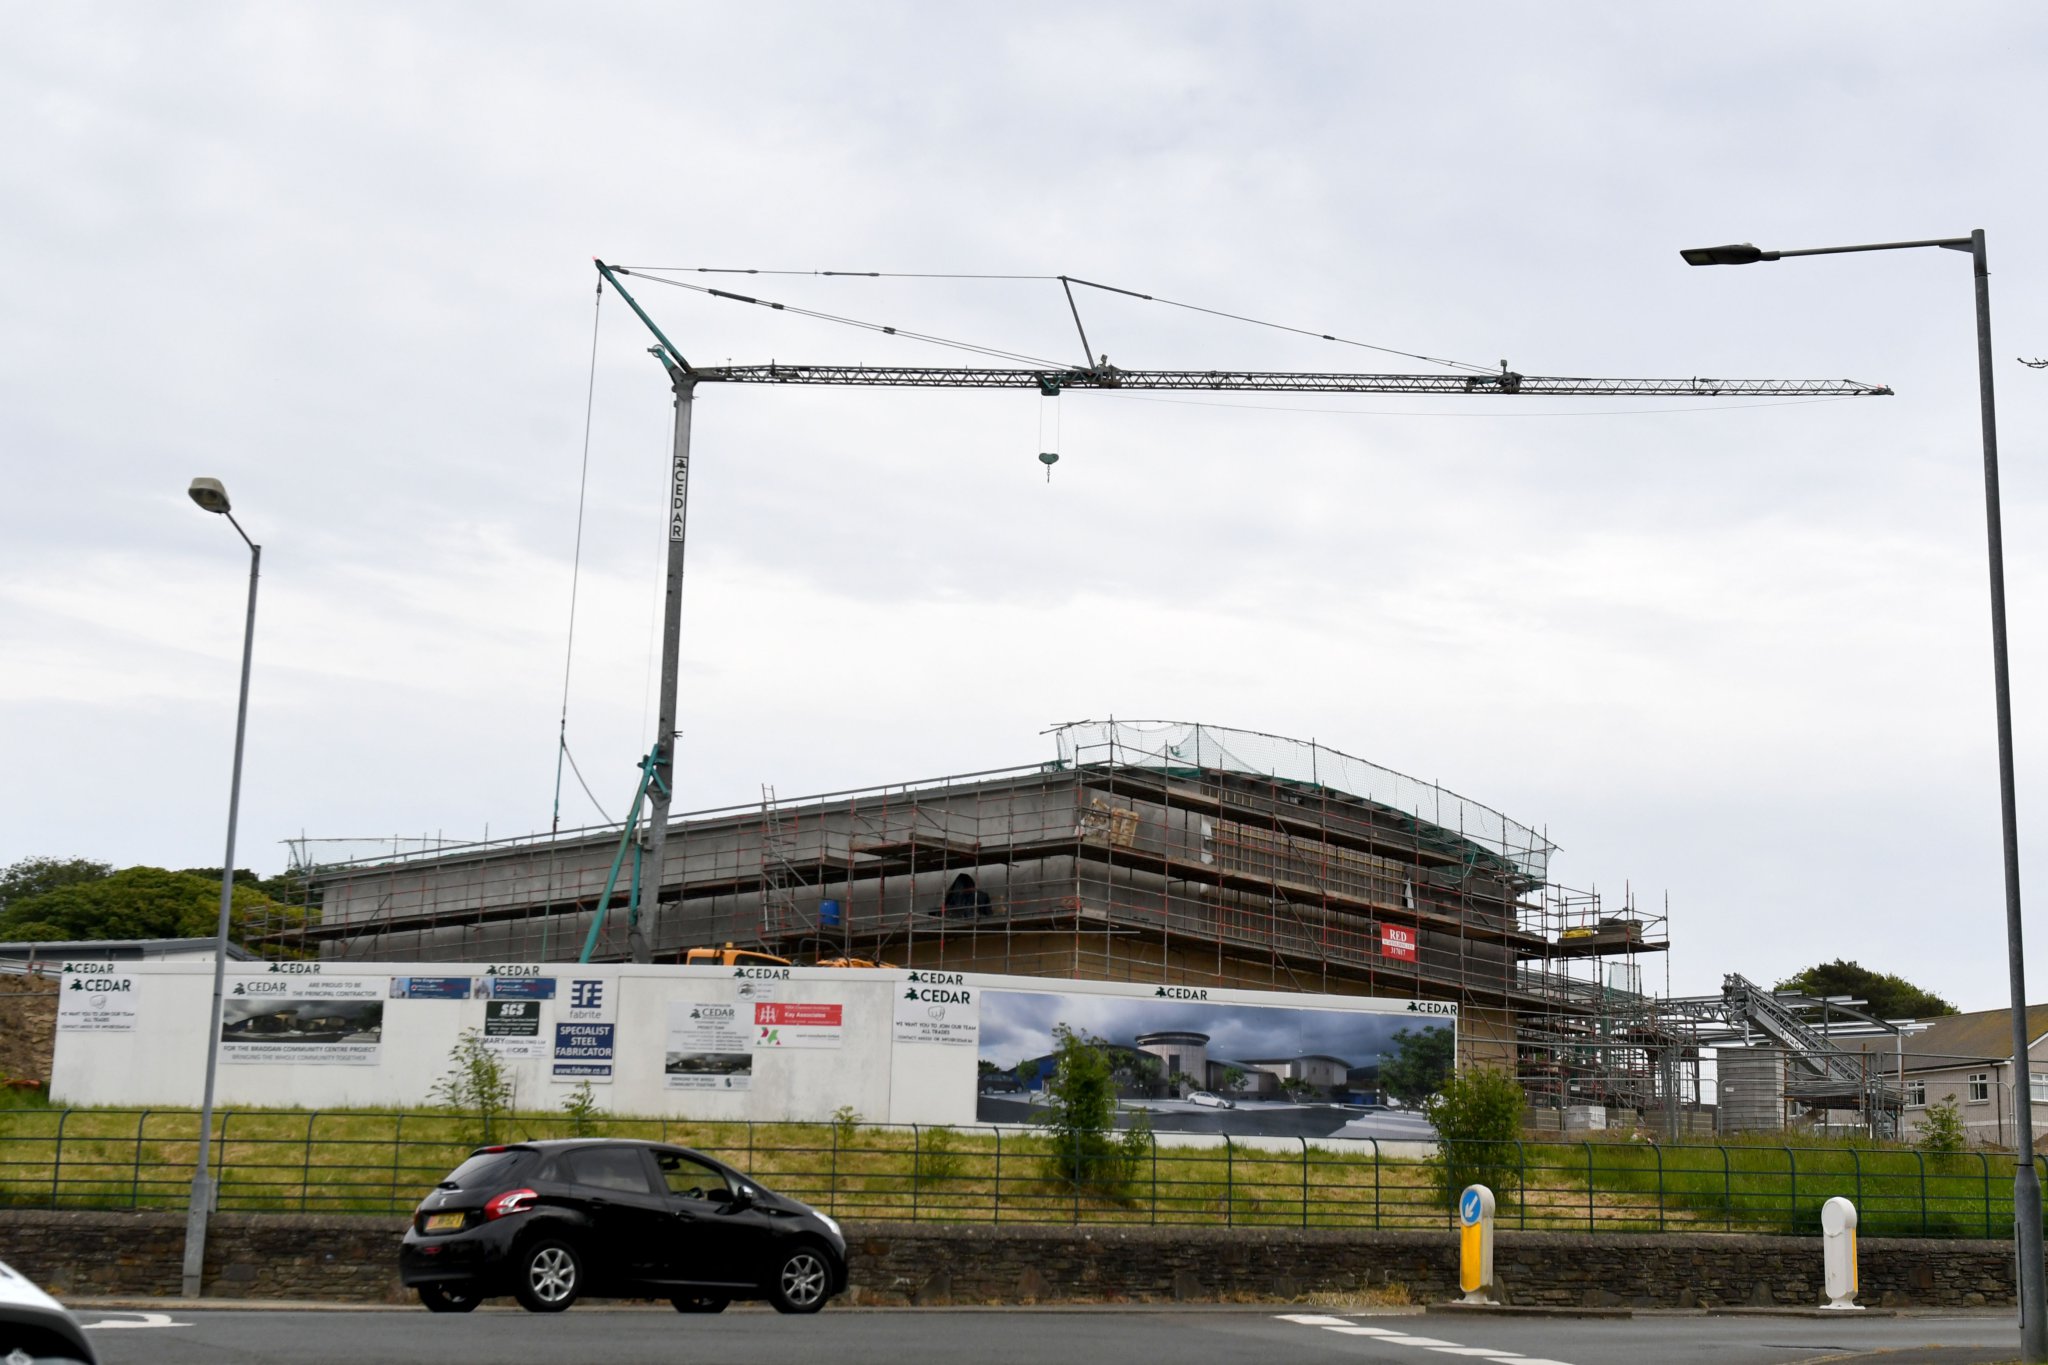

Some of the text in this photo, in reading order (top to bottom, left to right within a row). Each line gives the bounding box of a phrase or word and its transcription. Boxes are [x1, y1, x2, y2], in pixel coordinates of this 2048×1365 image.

[672, 470, 685, 537] CEDAR
[1390, 929, 1407, 941] RED
[74, 963, 114, 974] CEDAR
[280, 963, 321, 974] CEDAR
[498, 965, 540, 976] CEDAR
[746, 968, 790, 979] CEDAR
[920, 972, 963, 985] CEDAR
[85, 979, 131, 992] CEDAR
[247, 982, 287, 992] CEDAR
[921, 989, 970, 1004] CEDAR
[1167, 987, 1207, 1000] CEDAR
[500, 1003, 526, 1016] SCS
[570, 1010, 602, 1018] fabrite
[702, 1008, 735, 1016] CEDAR
[1418, 1002, 1457, 1015] CEDAR
[560, 1027, 610, 1035] SPECIALIST
[571, 1037, 598, 1045] STEEL
[555, 1047, 612, 1056] FABRICATOR
